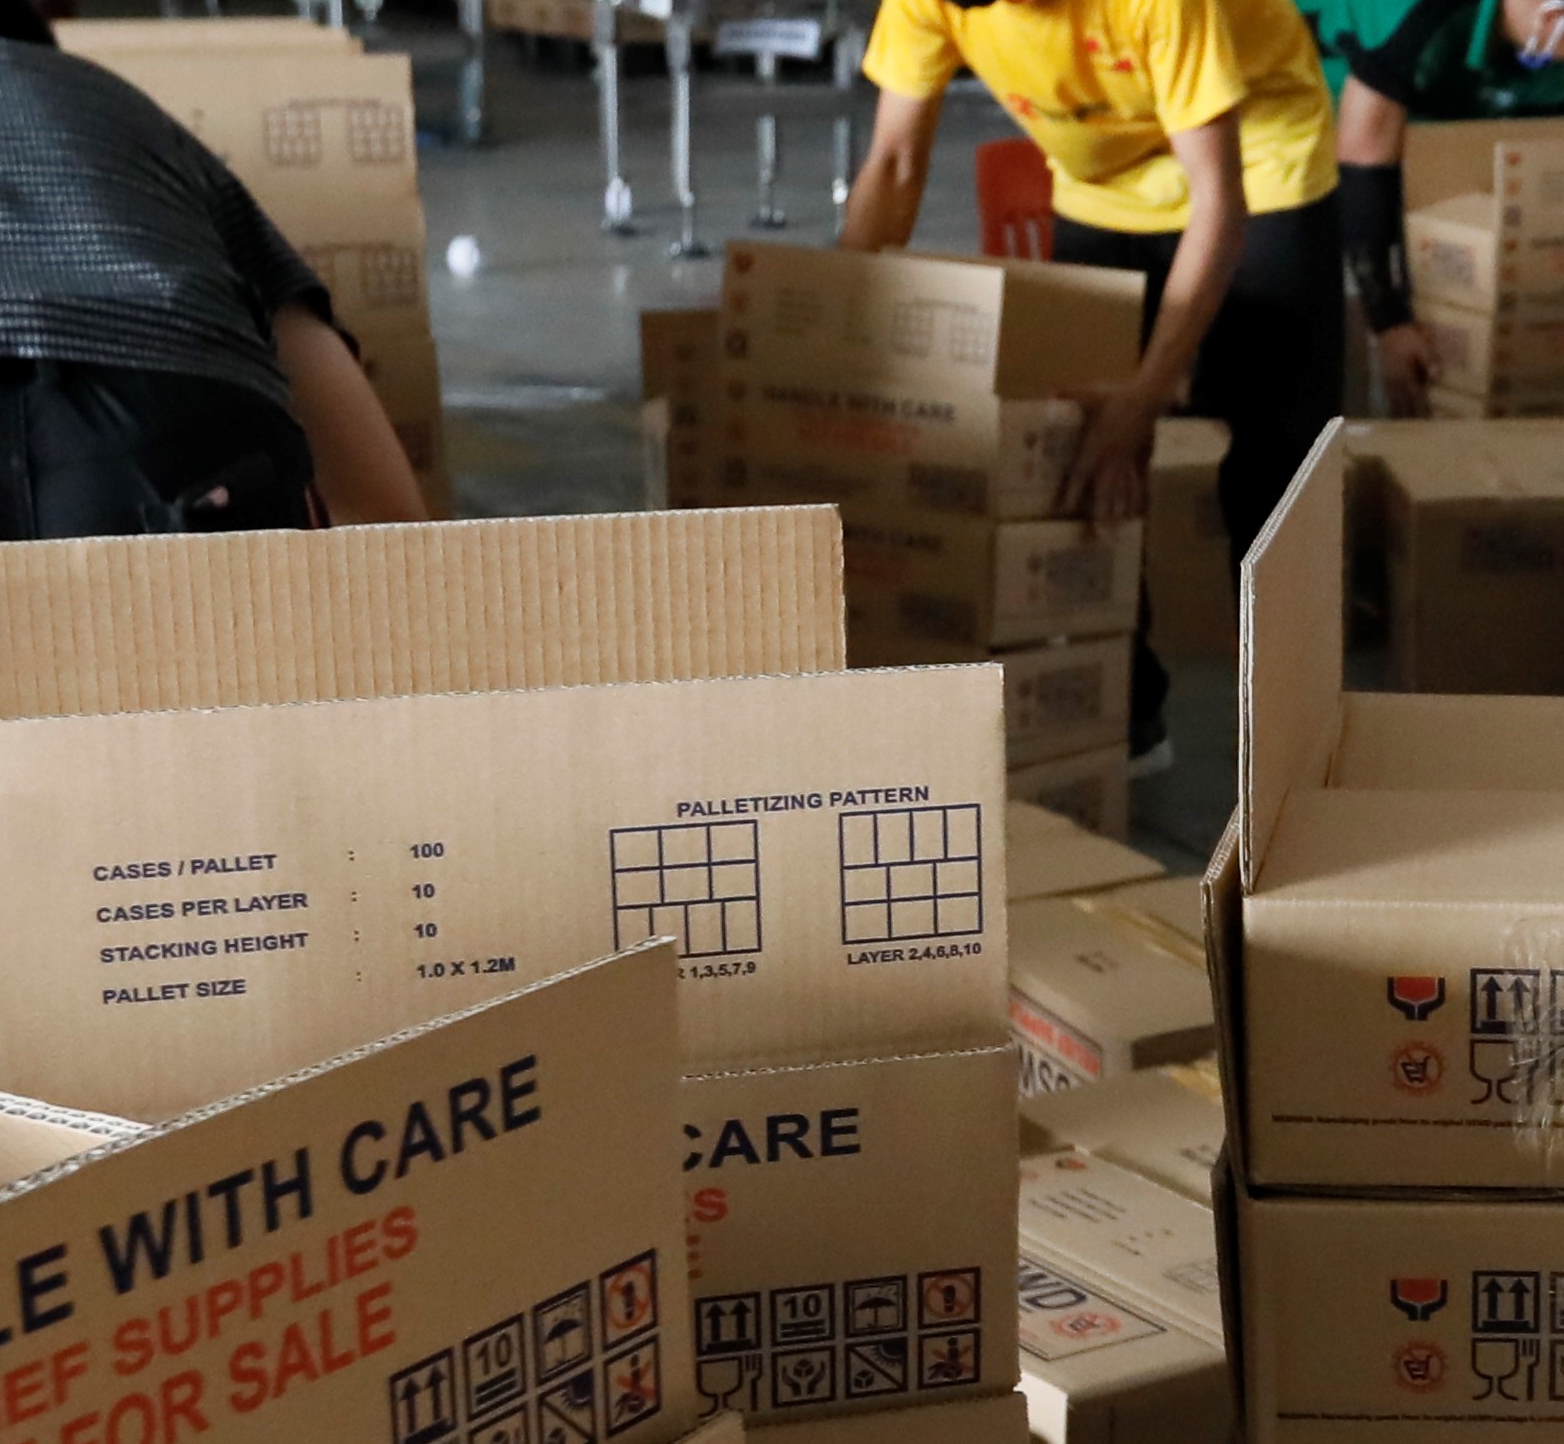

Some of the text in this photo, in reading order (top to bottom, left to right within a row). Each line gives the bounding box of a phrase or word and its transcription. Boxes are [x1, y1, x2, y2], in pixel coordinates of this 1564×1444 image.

[900, 398, 957, 422] CARE
[677, 785, 929, 818] PALLETIZING PATTERN
[410, 843, 444, 860] 100
[93, 854, 277, 883] CASES PALLET
[412, 883, 435, 899] 10
[96, 890, 309, 924] CASES PER LAYER
[414, 922, 437, 938] 10
[100, 931, 309, 964] STACKING HEIGHT
[848, 941, 983, 966] LAYER 2,4,6,8,10
[417, 956, 516, 980] 1.0 X 1.2M
[689, 961, 756, 980] 1,3,5,7,9
[102, 978, 246, 1005] PALLET SIZE
[98, 1146, 315, 1296] WITH
[341, 1054, 543, 1196] CARE
[110, 1205, 419, 1378] SUPPLIES
[782, 1293, 821, 1320] 10
[227, 1280, 398, 1415] SALE
